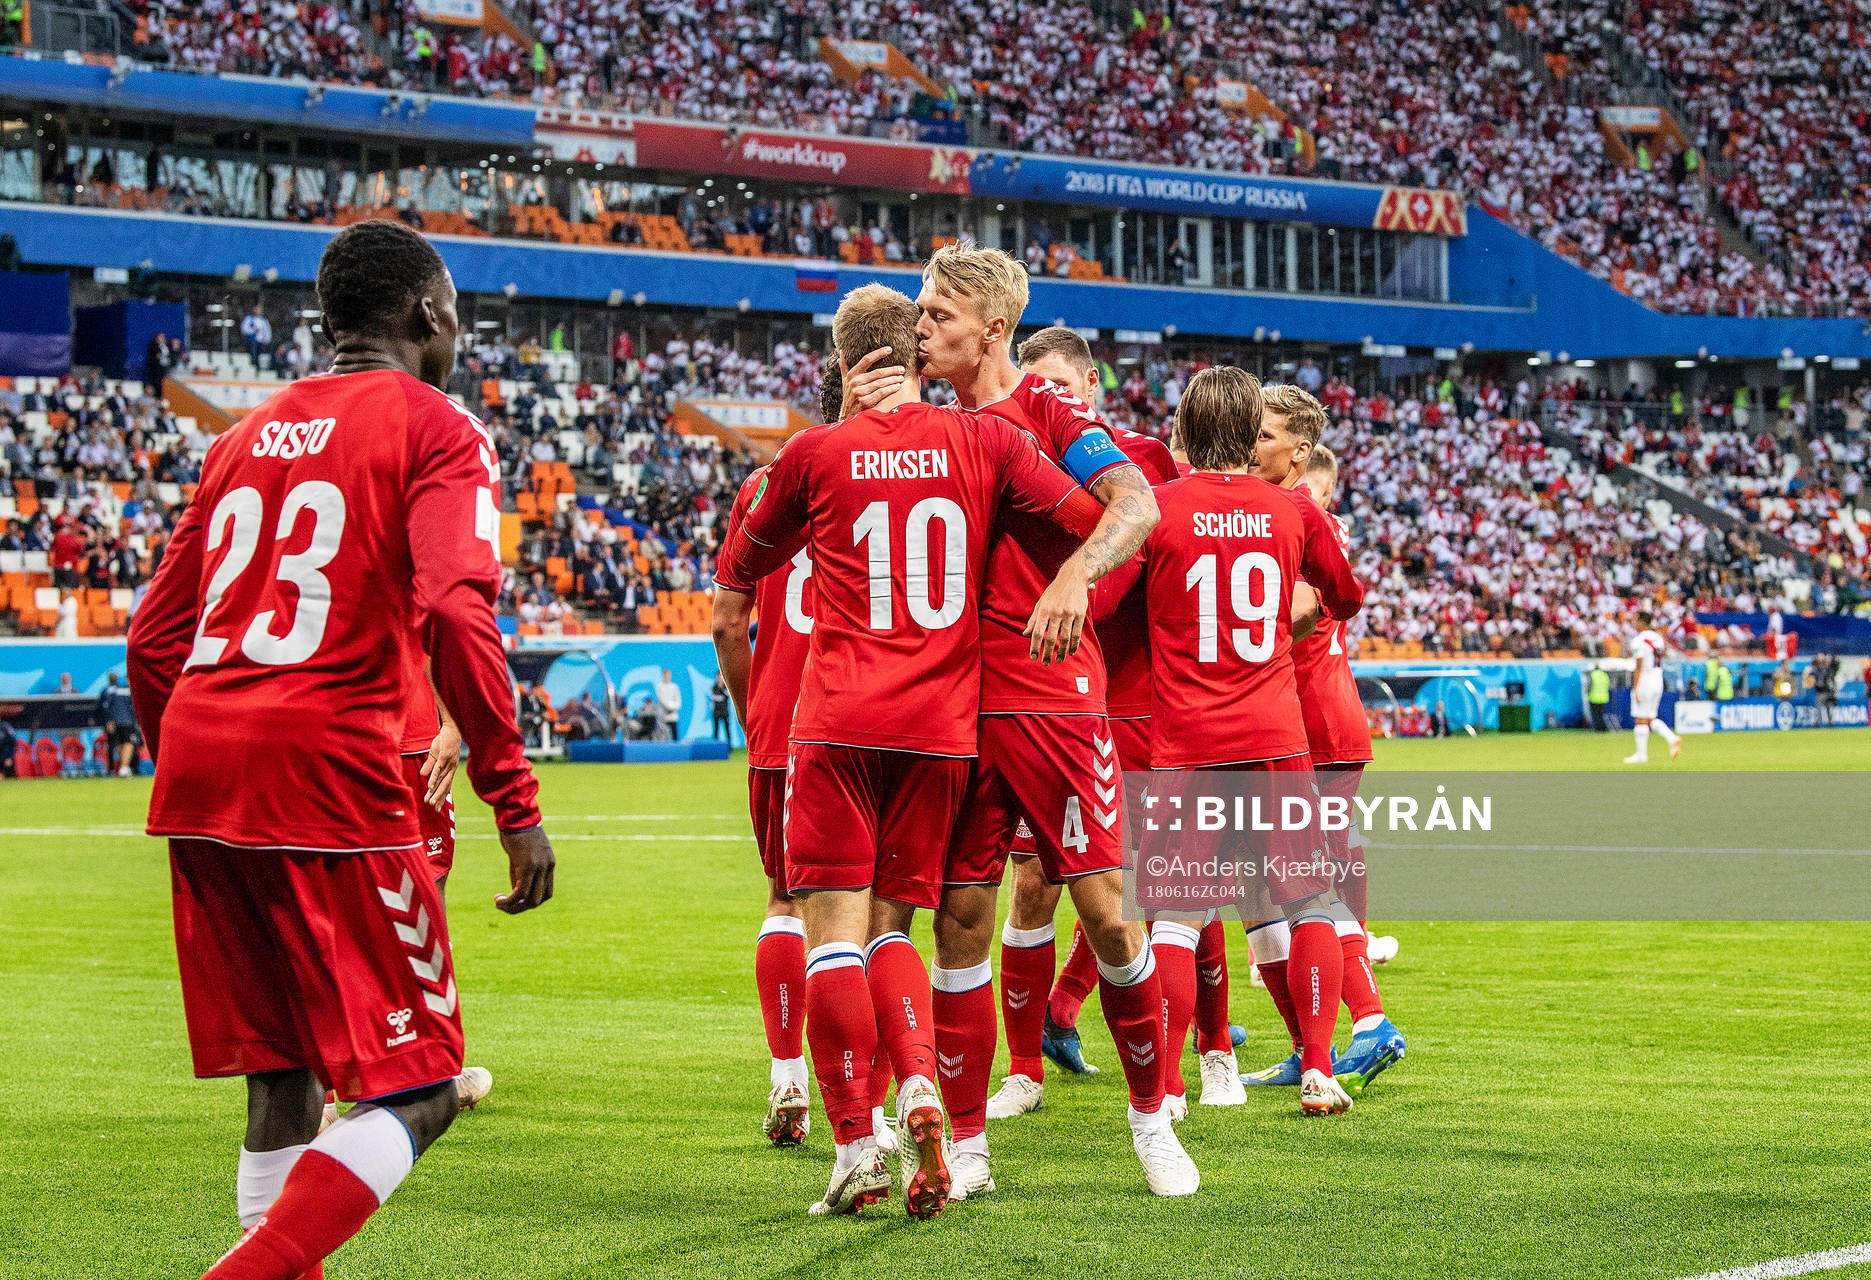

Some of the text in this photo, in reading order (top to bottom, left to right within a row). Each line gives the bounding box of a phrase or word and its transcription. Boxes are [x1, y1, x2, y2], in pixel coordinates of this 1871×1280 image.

[743, 137, 847, 175] #worldcup
[1064, 170, 1308, 211] 2018 FIFA WORLD CUP RUSSIA
[252, 417, 337, 460] SISTO
[851, 448, 949, 480] ERIKSEN
[1192, 509, 1273, 538] SCHÖNE
[181, 480, 347, 673] 23
[852, 497, 967, 630] 10
[1186, 551, 1282, 663] 19
[1061, 795, 1090, 854] 4
[779, 983, 789, 1029] DANMARK
[1311, 966, 1320, 1016] DANMARK
[902, 996, 918, 1030] DANM
[844, 1050, 853, 1082] DAN
